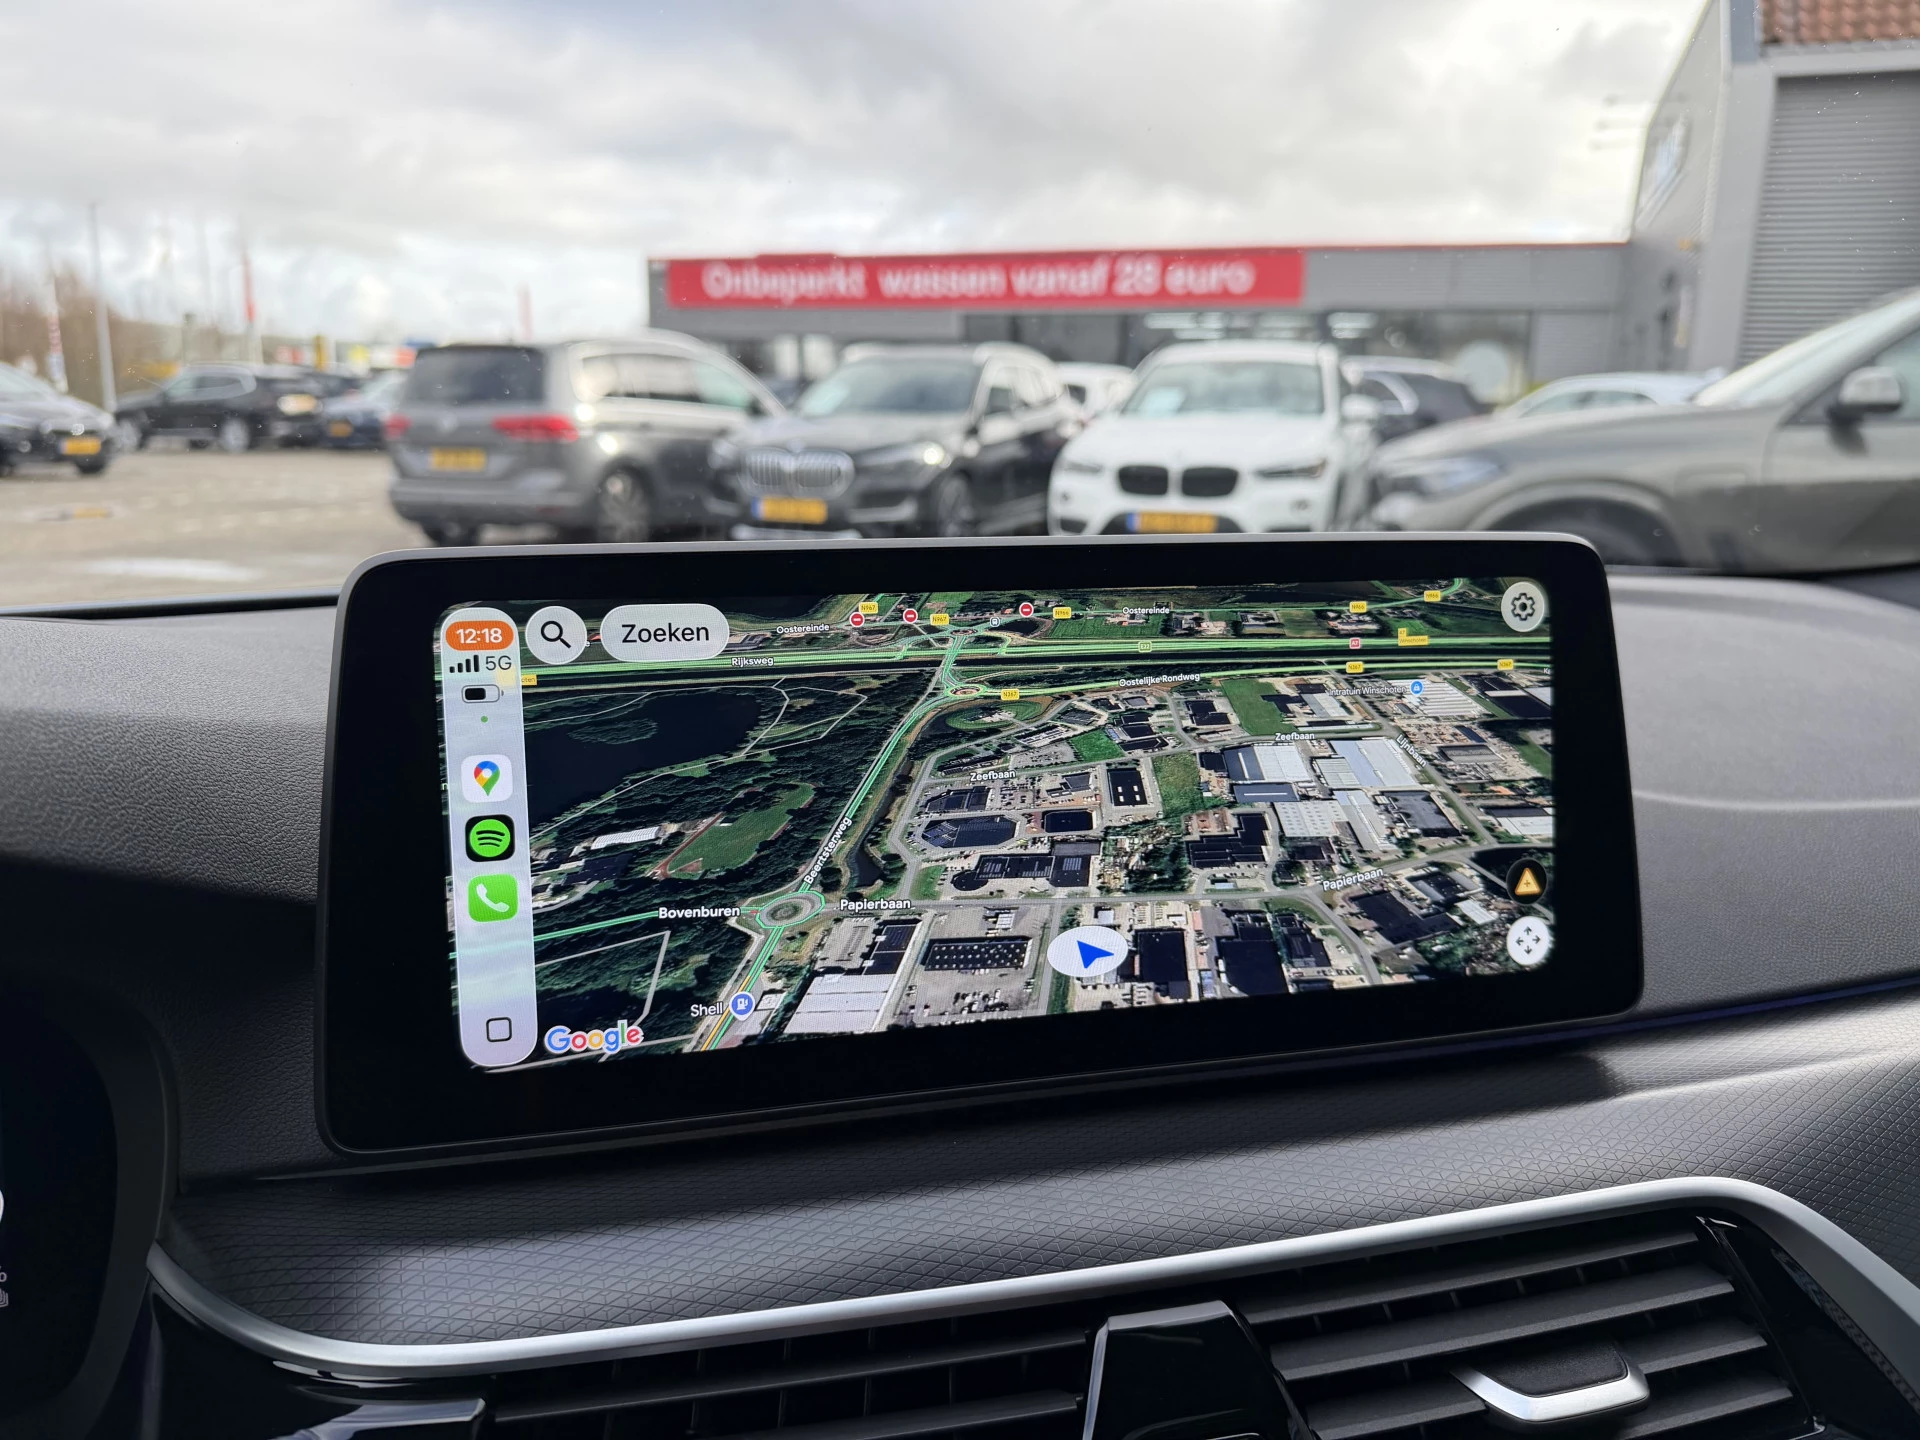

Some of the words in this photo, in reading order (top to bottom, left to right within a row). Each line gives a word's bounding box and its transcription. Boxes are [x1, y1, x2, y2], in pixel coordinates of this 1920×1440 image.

[1163, 259, 1256, 295] euro
[1122, 606, 1170, 615] Oostereinde
[456, 627, 503, 644] 12:18
[621, 622, 710, 643] Zoeken
[776, 624, 830, 635] Oostereinde
[485, 655, 512, 671] 5G
[731, 656, 774, 667] Rijksweg
[1119, 676, 1161, 687] Oostelijke
[1162, 673, 1201, 683] Rondweg
[1275, 731, 1316, 742] Zeefbaan
[1395, 734, 1428, 768] Lijnbaan
[969, 769, 1017, 783] Zeefbaan
[803, 816, 853, 885] Beertsterweg
[1322, 867, 1384, 892] Papierbaan
[839, 899, 912, 912] Papierbaan
[657, 906, 741, 921] Bovenburen
[690, 1002, 724, 1017] Shell
[544, 1019, 645, 1055] Google
